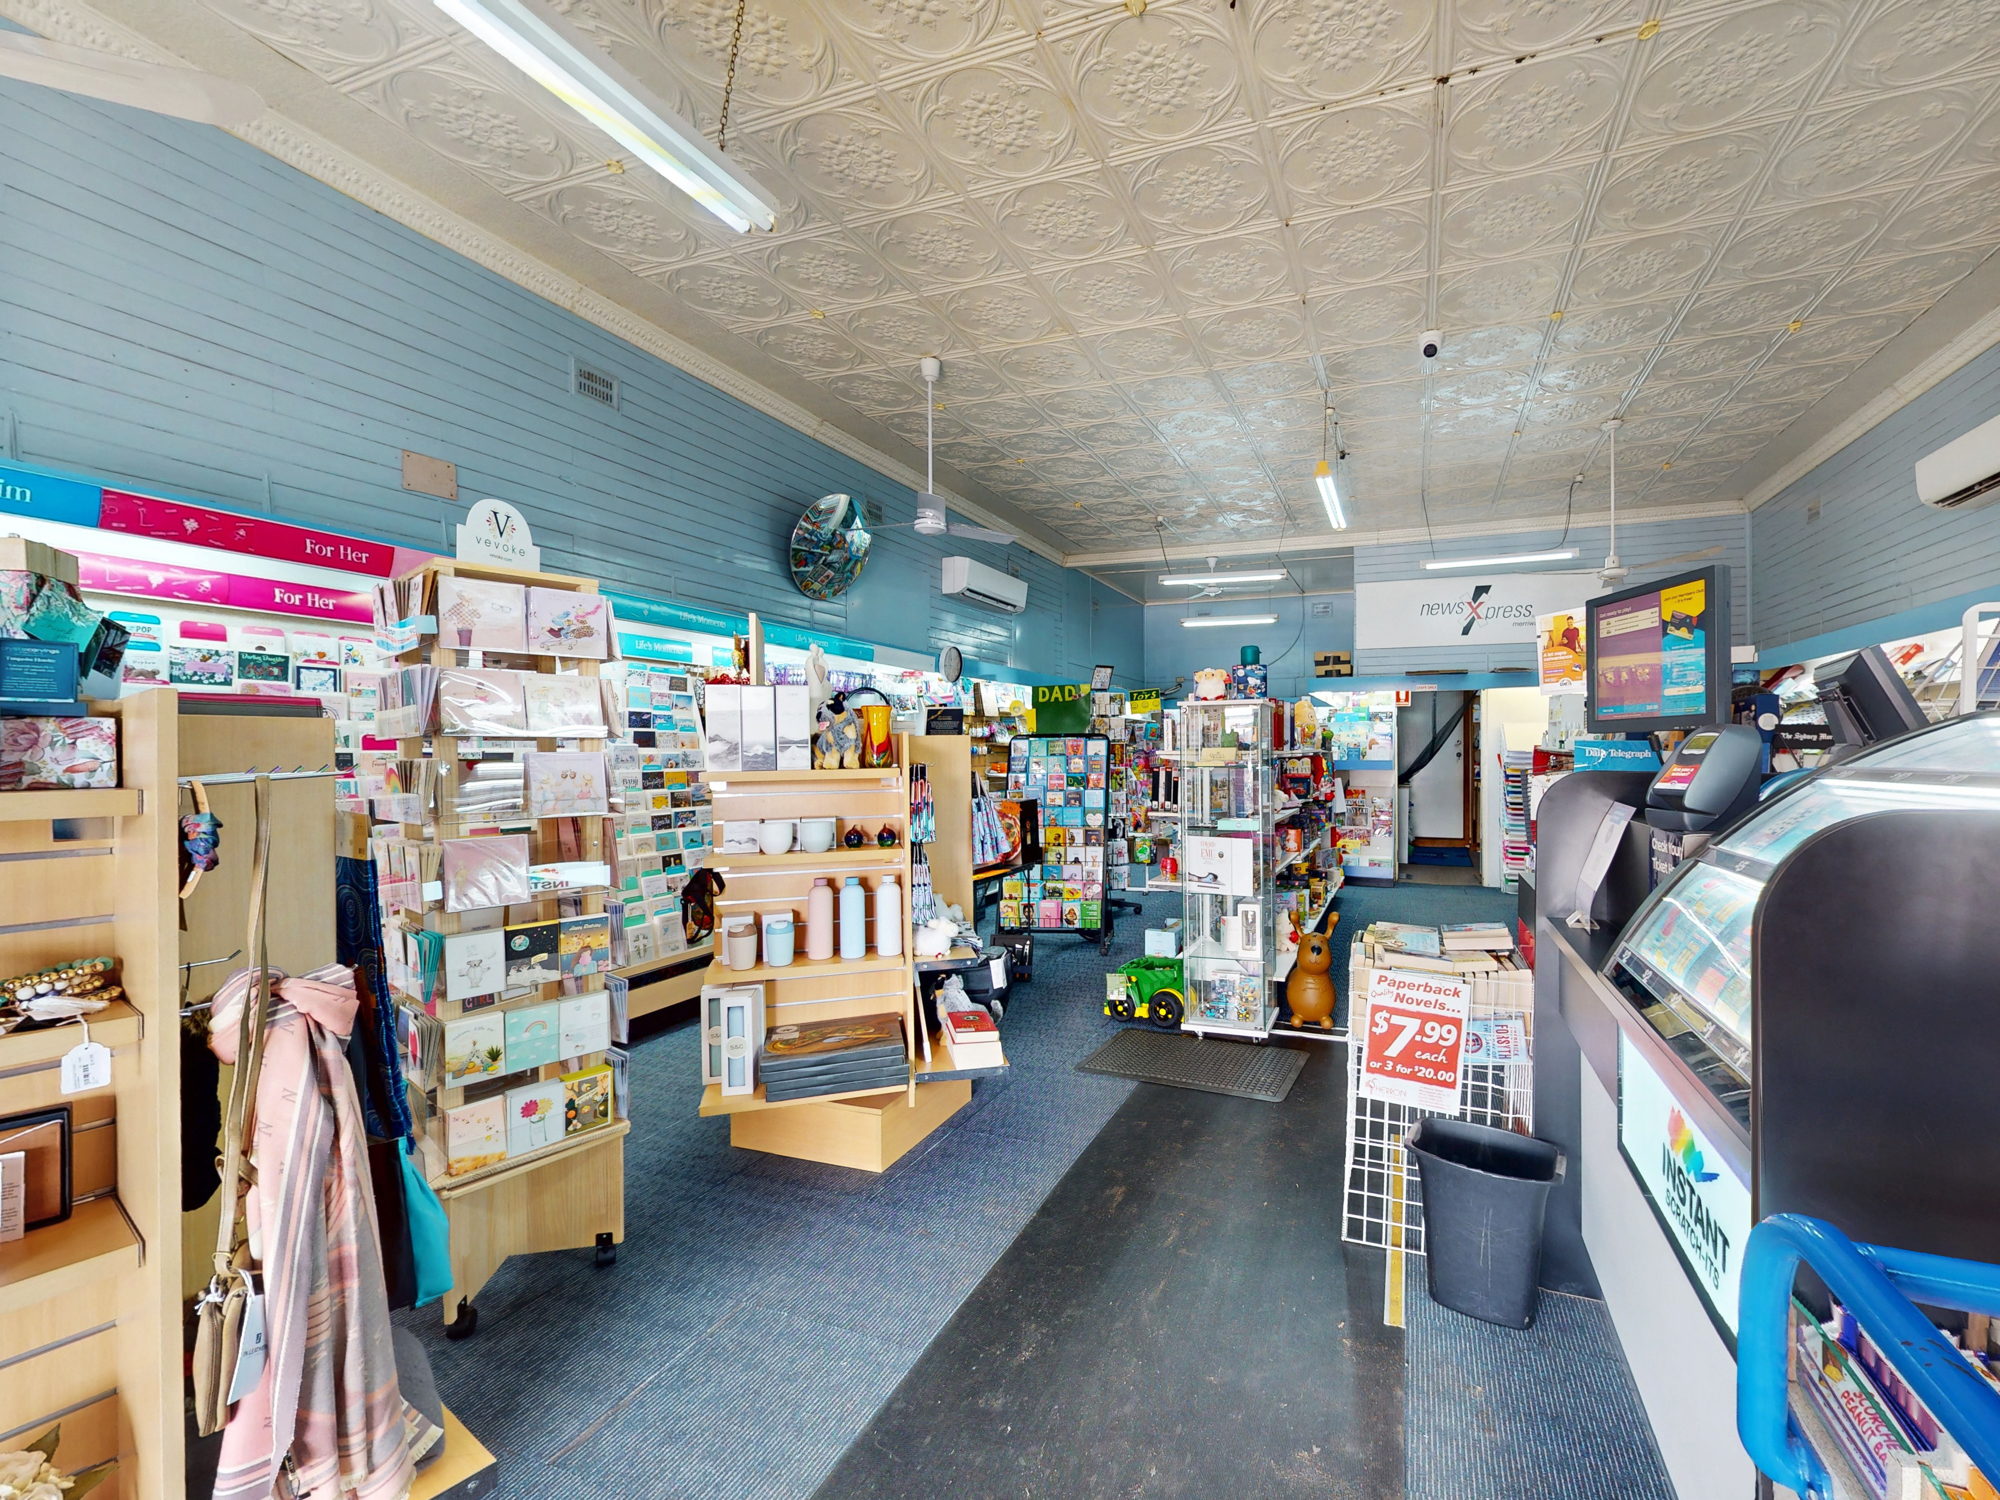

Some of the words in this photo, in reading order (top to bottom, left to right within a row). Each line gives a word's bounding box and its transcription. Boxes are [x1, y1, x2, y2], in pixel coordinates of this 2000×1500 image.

[305, 539, 334, 558] For
[340, 545, 370, 565] Her
[476, 536, 526, 557] vevoke
[273, 588, 304, 606] For
[307, 593, 337, 611] Her
[679, 611, 697, 623] Life's
[697, 614, 727, 629] Moments
[1420, 601, 1533, 620] newsXpress
[635, 640, 653, 651] Life's
[653, 642, 684, 655] Moments
[795, 634, 808, 645] Life's
[1038, 686, 1076, 702] DAD
[1794, 733, 1818, 741] Sydney
[1609, 749, 1652, 759] Telegraph
[1652, 837, 1668, 852] Check
[1667, 841, 1683, 860] Your
[1652, 857, 1670, 873] Ticket
[1370, 988, 1394, 998] Quality
[1376, 975, 1462, 998] Paperback
[465, 993, 494, 1008] GIRL
[1393, 992, 1461, 1013] Novels...
[1371, 1009, 1458, 1058] $7.99
[1415, 1048, 1448, 1064] each
[1369, 1060, 1382, 1069] or
[1384, 1061, 1394, 1071] 3
[1395, 1064, 1413, 1075] for
[1414, 1065, 1455, 1083] $20.00
[1375, 1084, 1407, 1097] HERRON
[1662, 1141, 1730, 1274] INSTANT
[1665, 1188, 1720, 1290] SCRATCH-ITS
[1841, 1390, 1876, 1442] PEANUT
